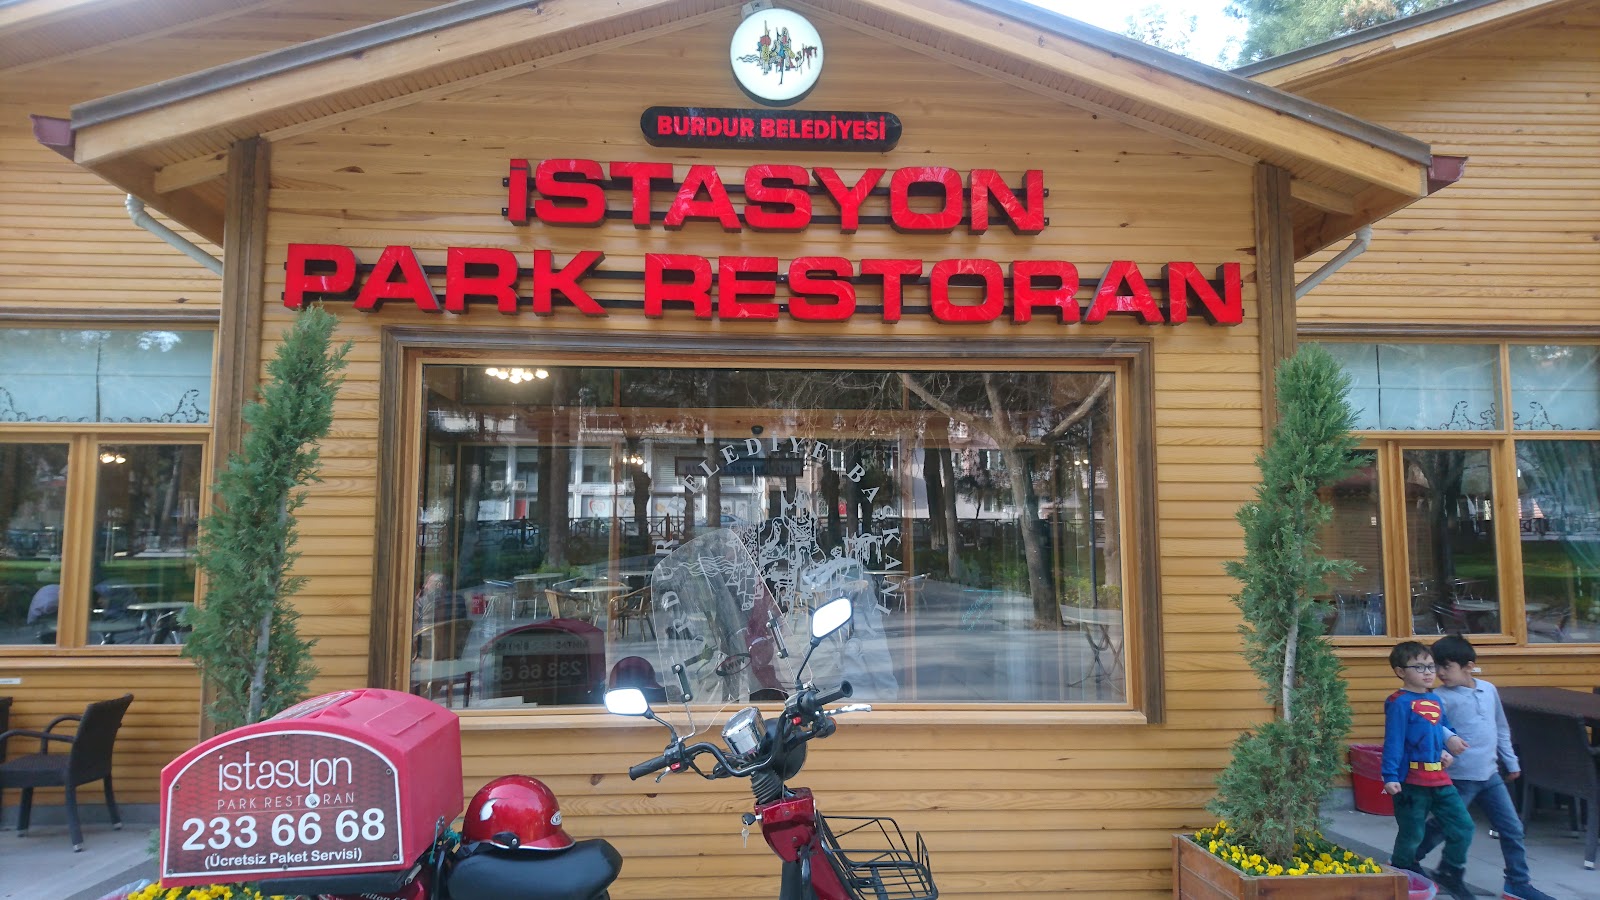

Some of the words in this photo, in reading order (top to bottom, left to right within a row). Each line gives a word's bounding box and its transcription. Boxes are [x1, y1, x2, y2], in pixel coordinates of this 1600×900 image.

[657, 115, 754, 138] BURDUR
[760, 114, 887, 141] BELEDİYESİ
[507, 157, 1045, 236] İSTASYON
[284, 242, 608, 318] PARK
[644, 252, 1244, 326] RESTORAN
[218, 750, 353, 794] istasyon
[217, 798, 257, 811] PARK
[182, 815, 258, 850] 233
[271, 812, 322, 847] 66
[335, 807, 386, 843] 68
[204, 852, 267, 870] (Ücretsiz
[270, 850, 308, 864] Paket
[311, 847, 363, 862] Servisi)
